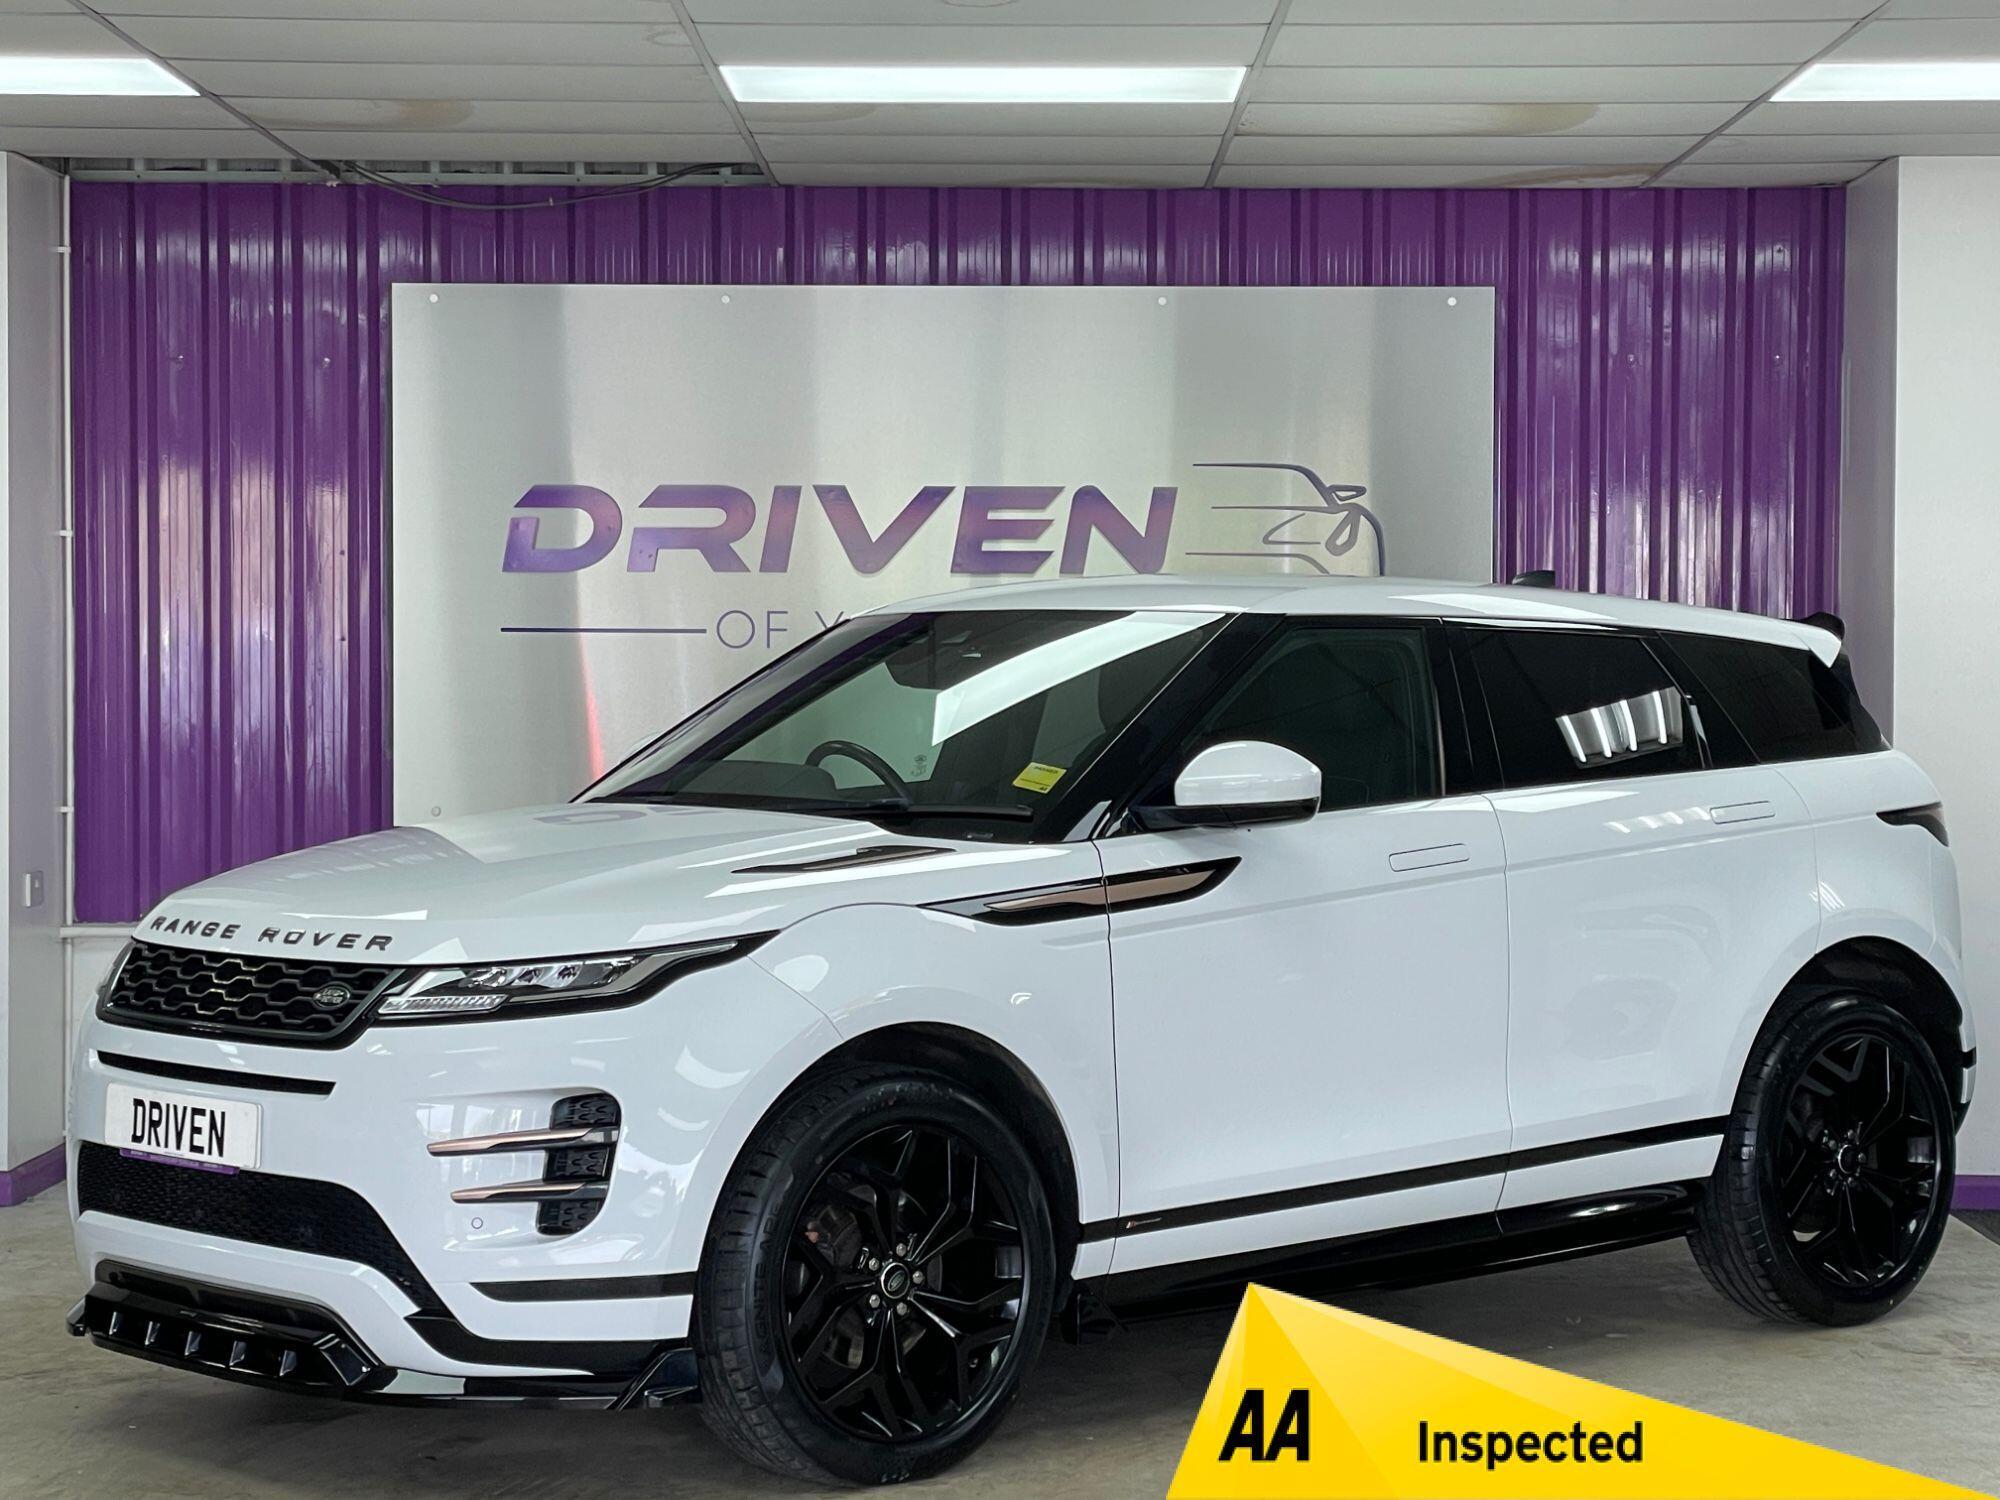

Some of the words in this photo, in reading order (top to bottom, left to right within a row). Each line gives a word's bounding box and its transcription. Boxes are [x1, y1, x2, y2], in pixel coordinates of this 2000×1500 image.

[502, 484, 1178, 576] DRIVEN
[716, 610, 789, 649] OF
[150, 916, 241, 939] RANGE
[258, 927, 393, 951] ROVER
[131, 1097, 226, 1158] DRIVEN
